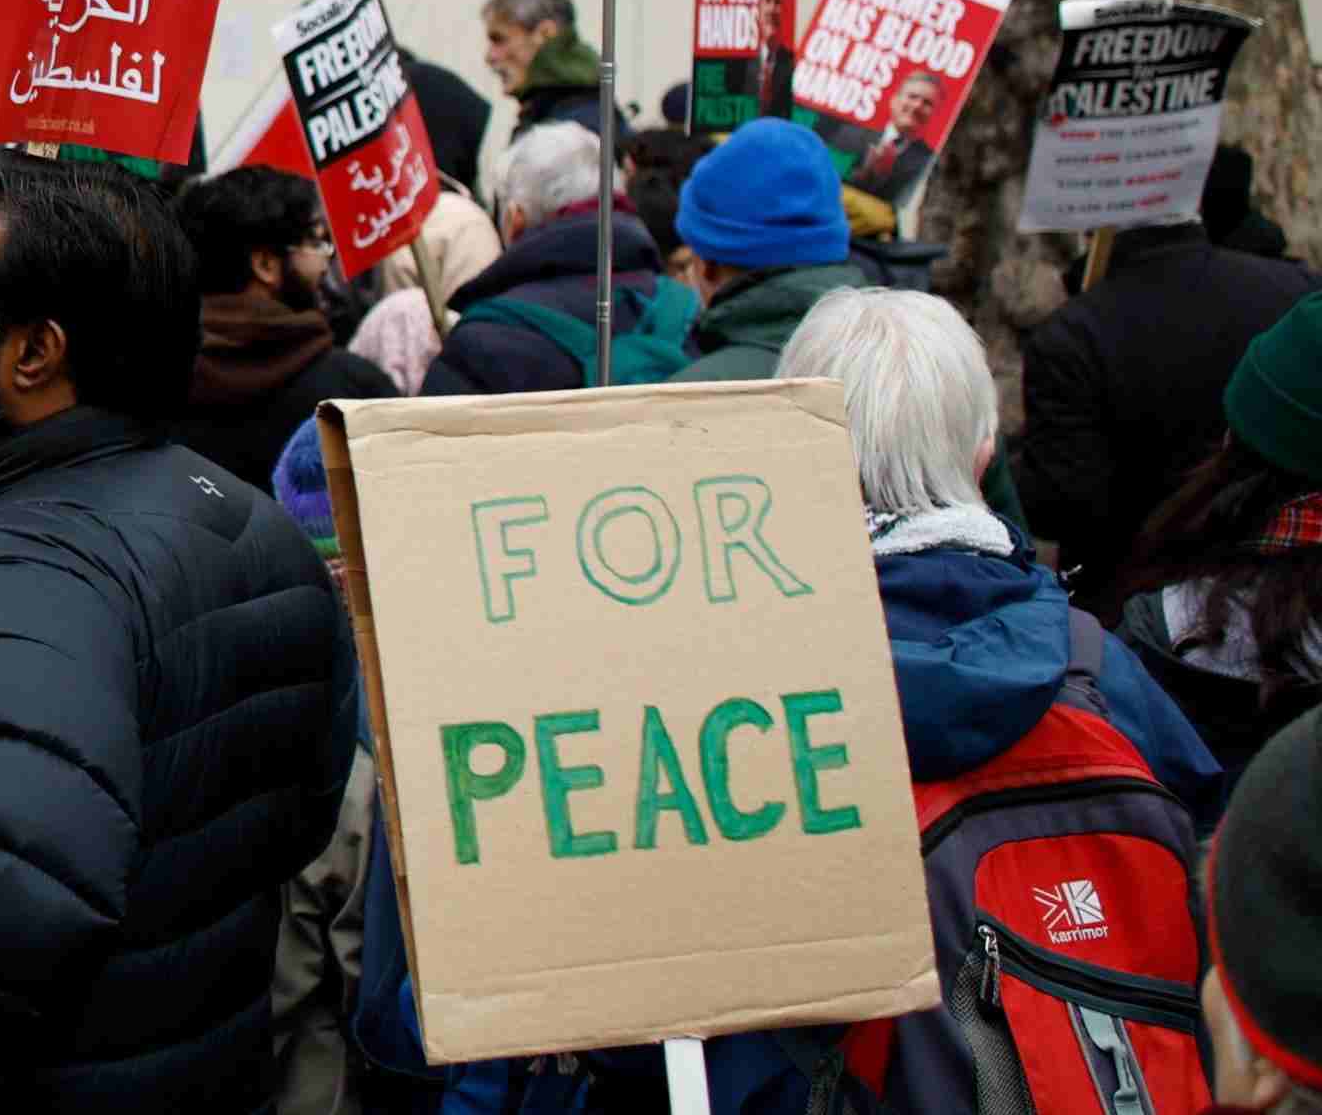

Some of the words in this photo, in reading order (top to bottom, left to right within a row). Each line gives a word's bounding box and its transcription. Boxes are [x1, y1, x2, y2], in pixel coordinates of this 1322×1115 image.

[805, 27, 851, 73] ON
[842, 42, 900, 89] HIS
[873, 12, 976, 79] BLOOD
[1073, 24, 1227, 66] FREEDOM
[793, 58, 883, 122] HANDS
[471, 474, 813, 624] FOR
[439, 688, 862, 866] PEACE
[1047, 925, 1109, 944] karrimor
